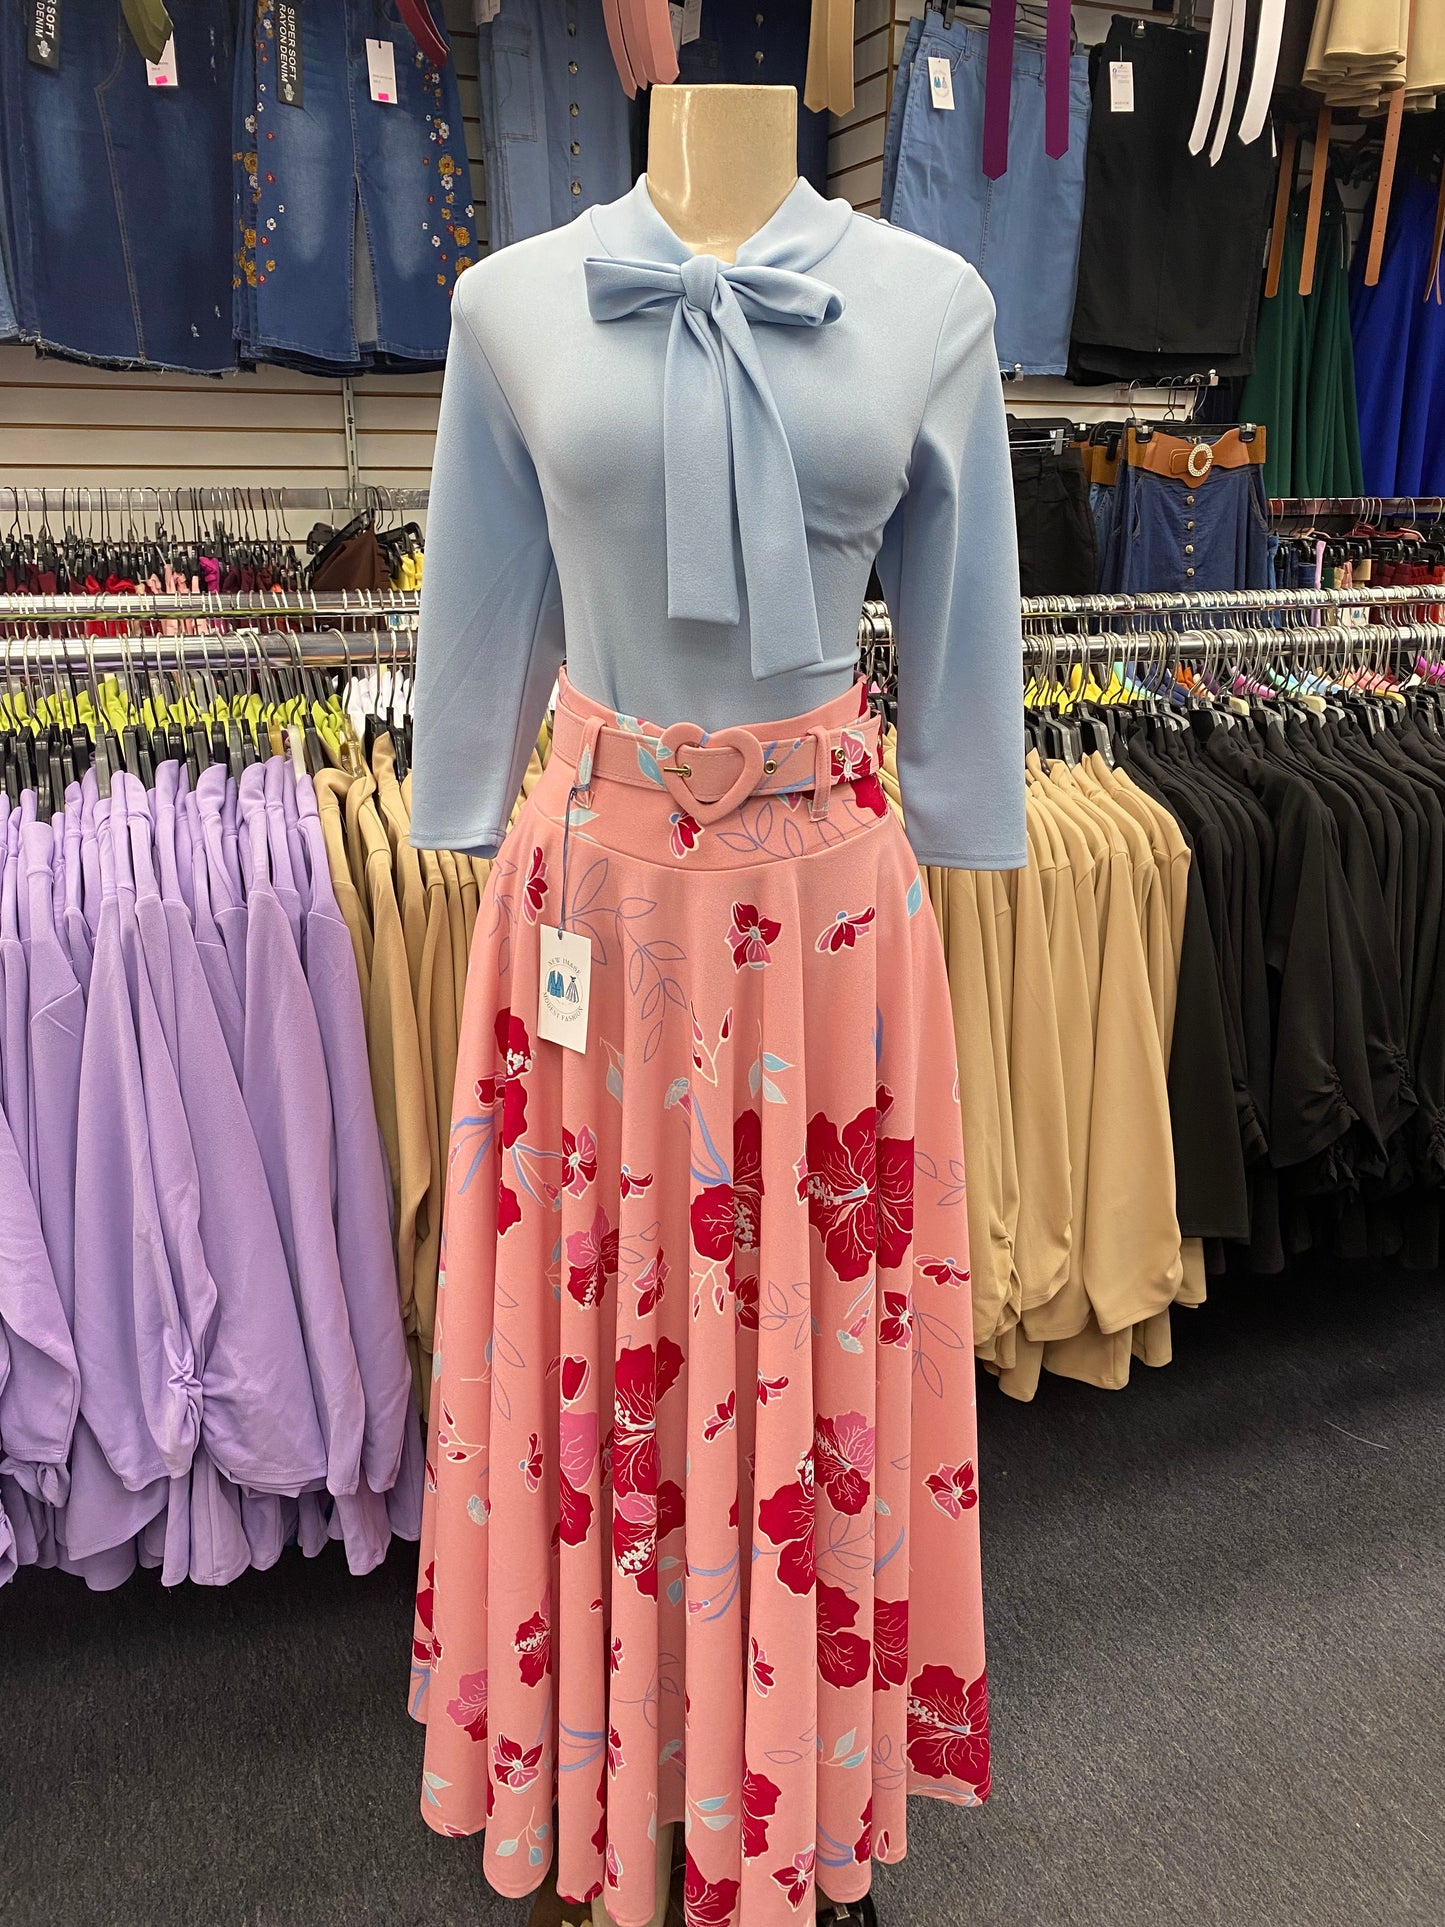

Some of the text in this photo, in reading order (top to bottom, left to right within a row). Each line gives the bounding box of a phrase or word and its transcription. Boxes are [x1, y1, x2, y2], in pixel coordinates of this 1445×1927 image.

[35, 2, 45, 38] DENIM
[46, 6, 56, 38] SOFT
[279, 3, 289, 83] RAYON DENIM
[287, 7, 297, 81] SUPER SOFT
